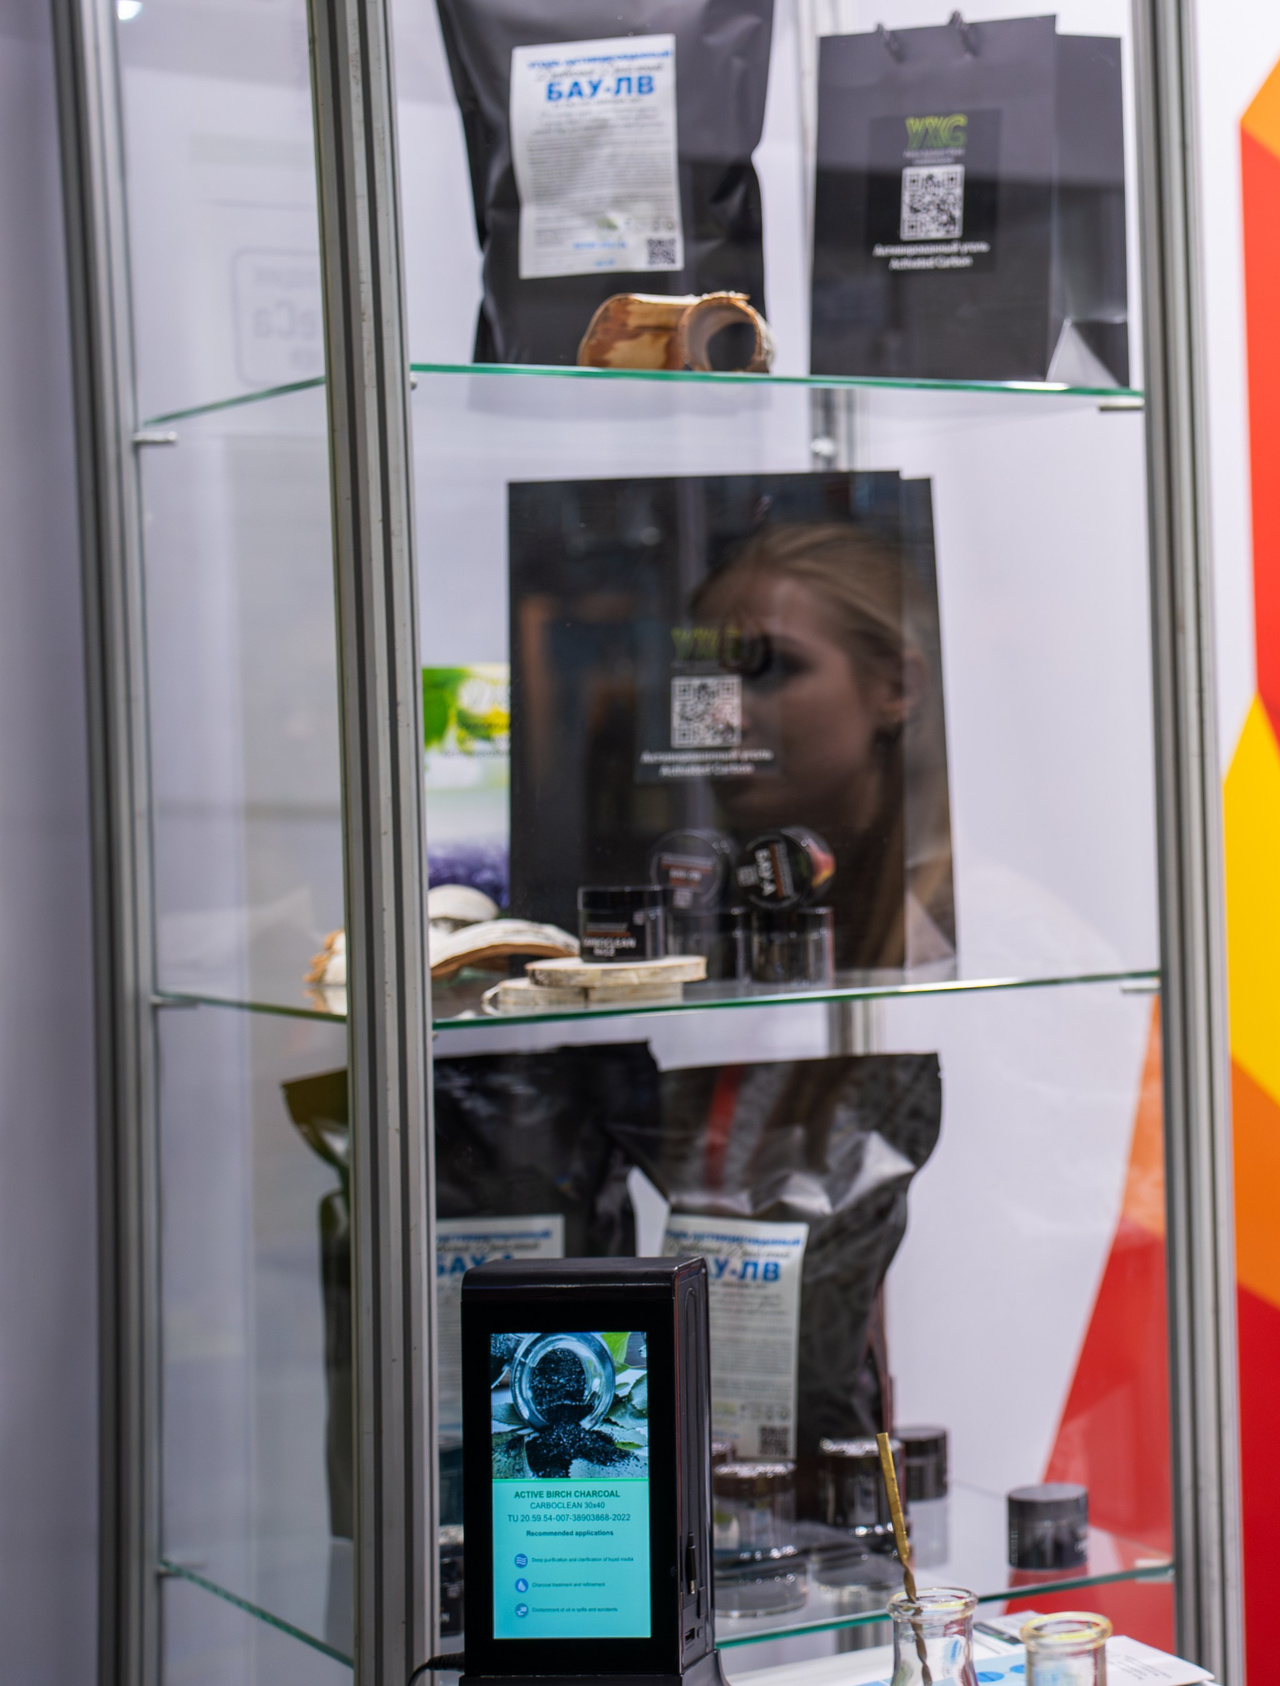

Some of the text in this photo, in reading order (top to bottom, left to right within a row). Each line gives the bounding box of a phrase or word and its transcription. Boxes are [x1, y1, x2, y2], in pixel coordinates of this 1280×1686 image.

[546, 75, 655, 102] БАУ-ЛВ
[706, 1256, 781, 1282] У-ЛВ
[514, 1490, 620, 1499] ACTIVE BIRCH CHARCOAL
[584, 1501, 605, 1509] 30x40
[507, 1514, 519, 1522] TU
